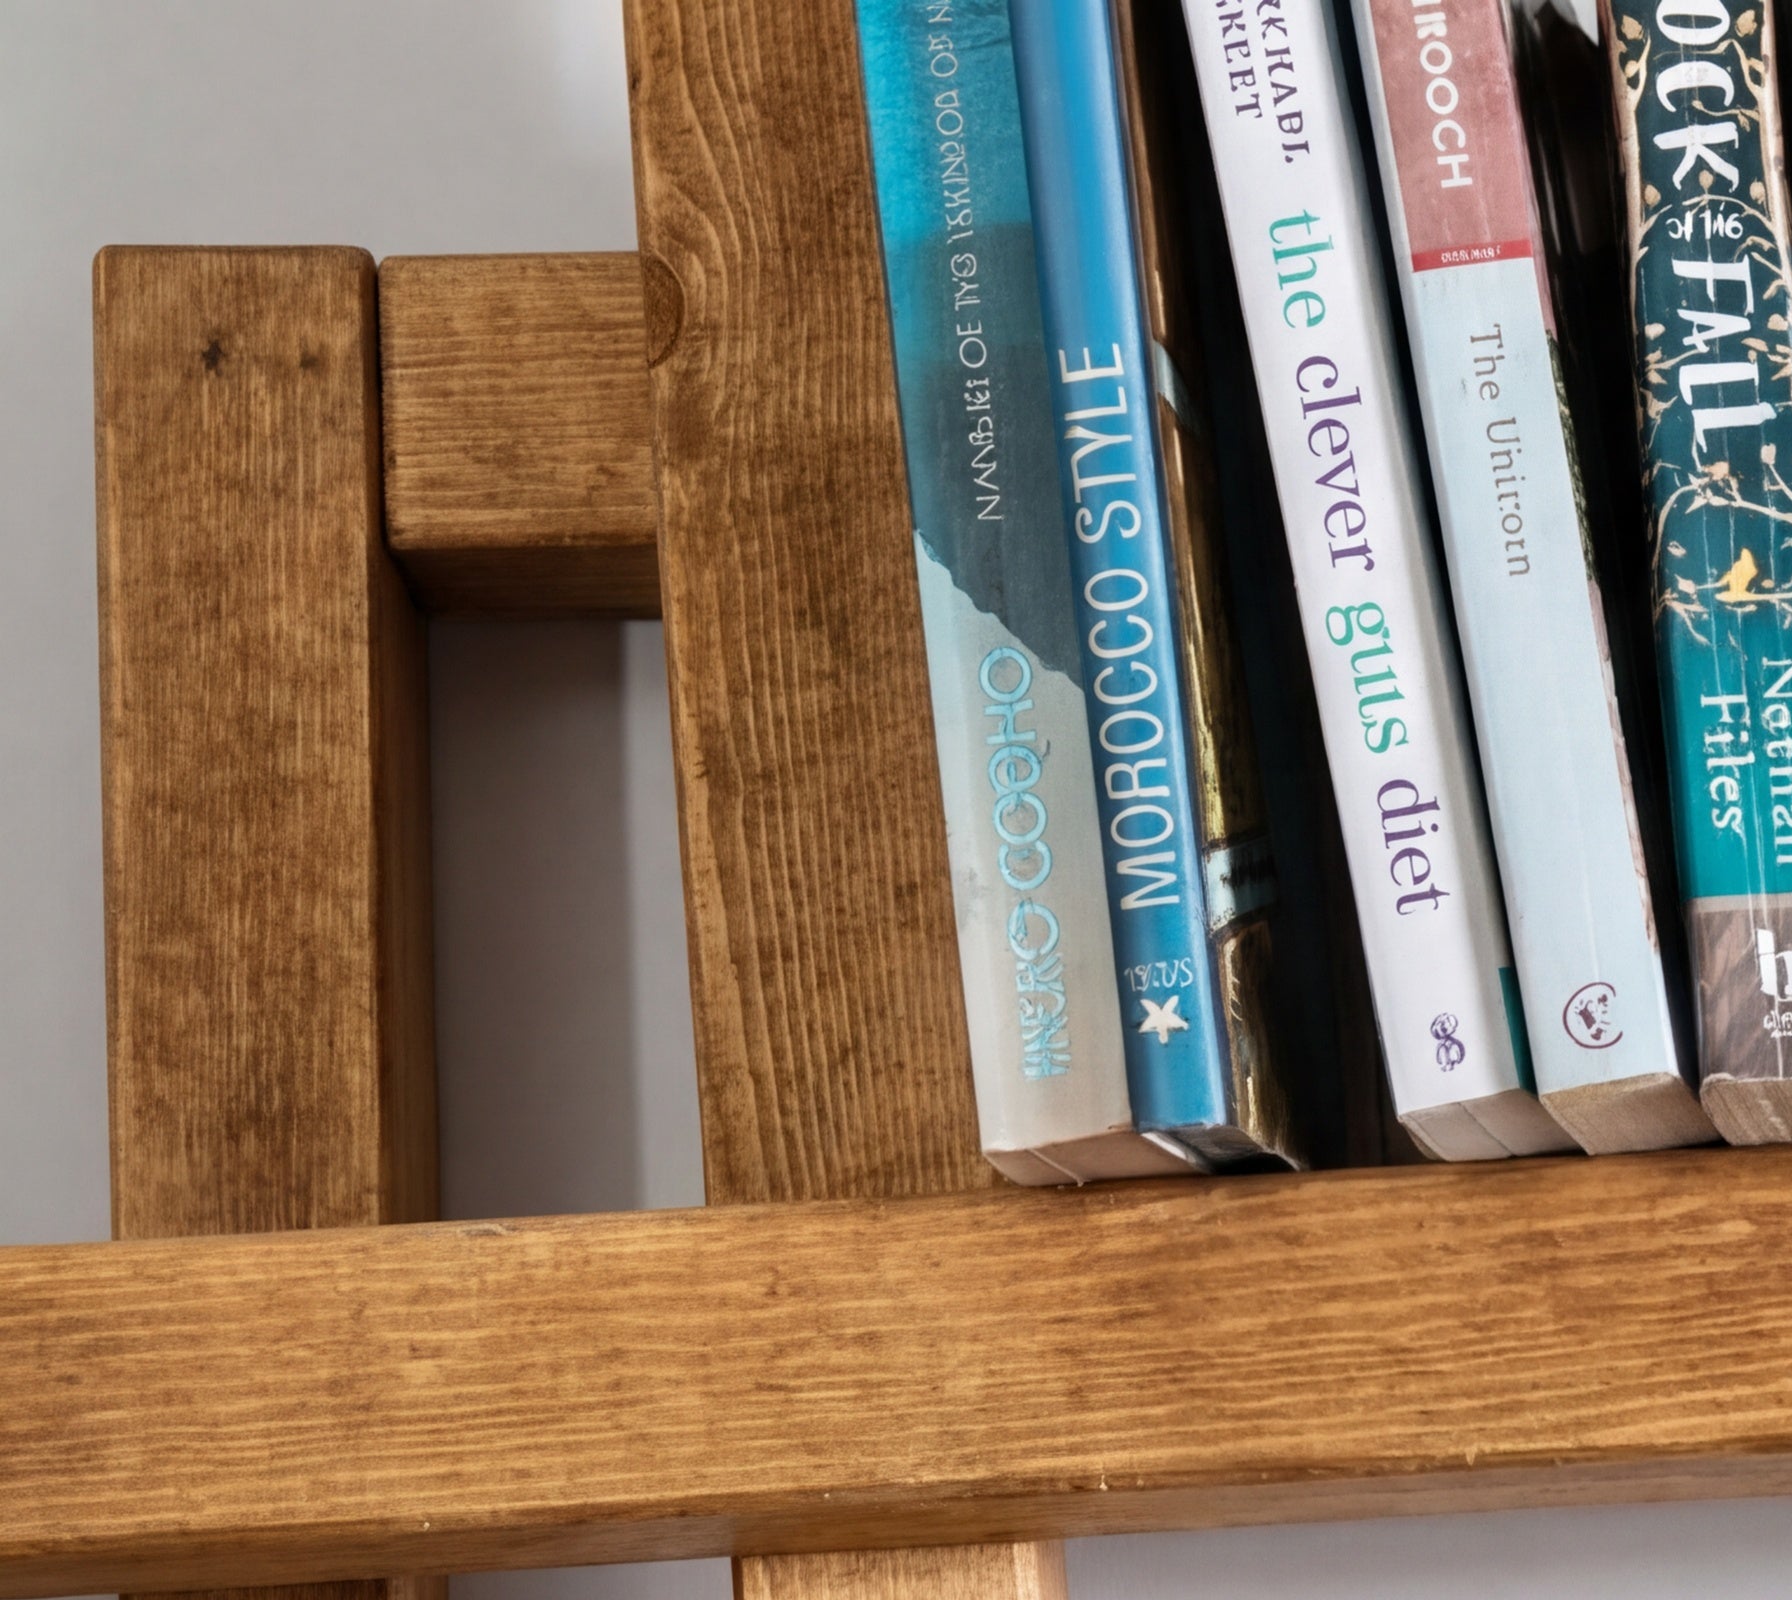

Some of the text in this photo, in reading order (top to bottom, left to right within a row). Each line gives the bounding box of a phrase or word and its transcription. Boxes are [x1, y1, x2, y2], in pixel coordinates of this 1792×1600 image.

[1268, 208, 1336, 330] the
[1469, 322, 1506, 402] The
[1671, 254, 1777, 452] FALL
[1058, 342, 1142, 544] STYLE
[1295, 354, 1376, 573] clever
[1083, 568, 1180, 912] MOROCCO
[1376, 778, 1451, 916] diet
